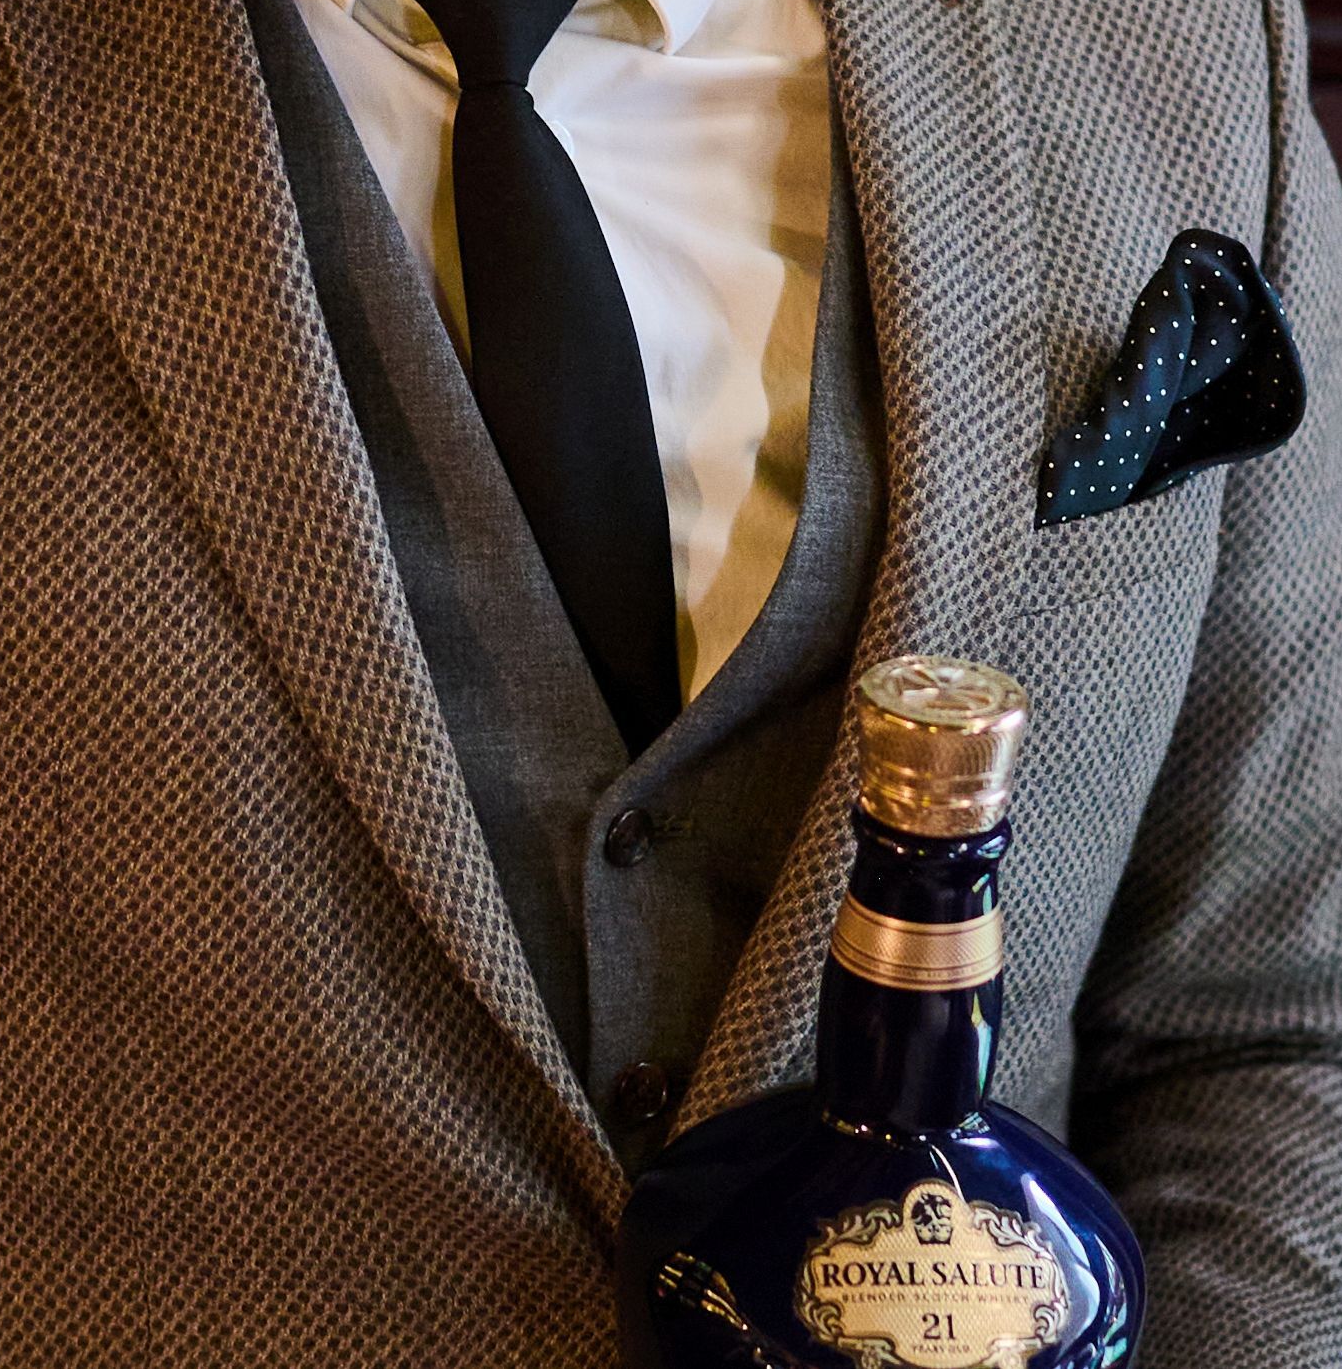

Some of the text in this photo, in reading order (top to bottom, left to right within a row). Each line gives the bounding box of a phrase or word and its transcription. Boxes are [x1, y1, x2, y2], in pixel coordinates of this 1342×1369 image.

[821, 1261, 1046, 1289] ROYAL SALUTE
[842, 1292, 905, 1303] BLENDED
[914, 1292, 969, 1303] SCOTCH
[921, 1313, 956, 1340] 21
